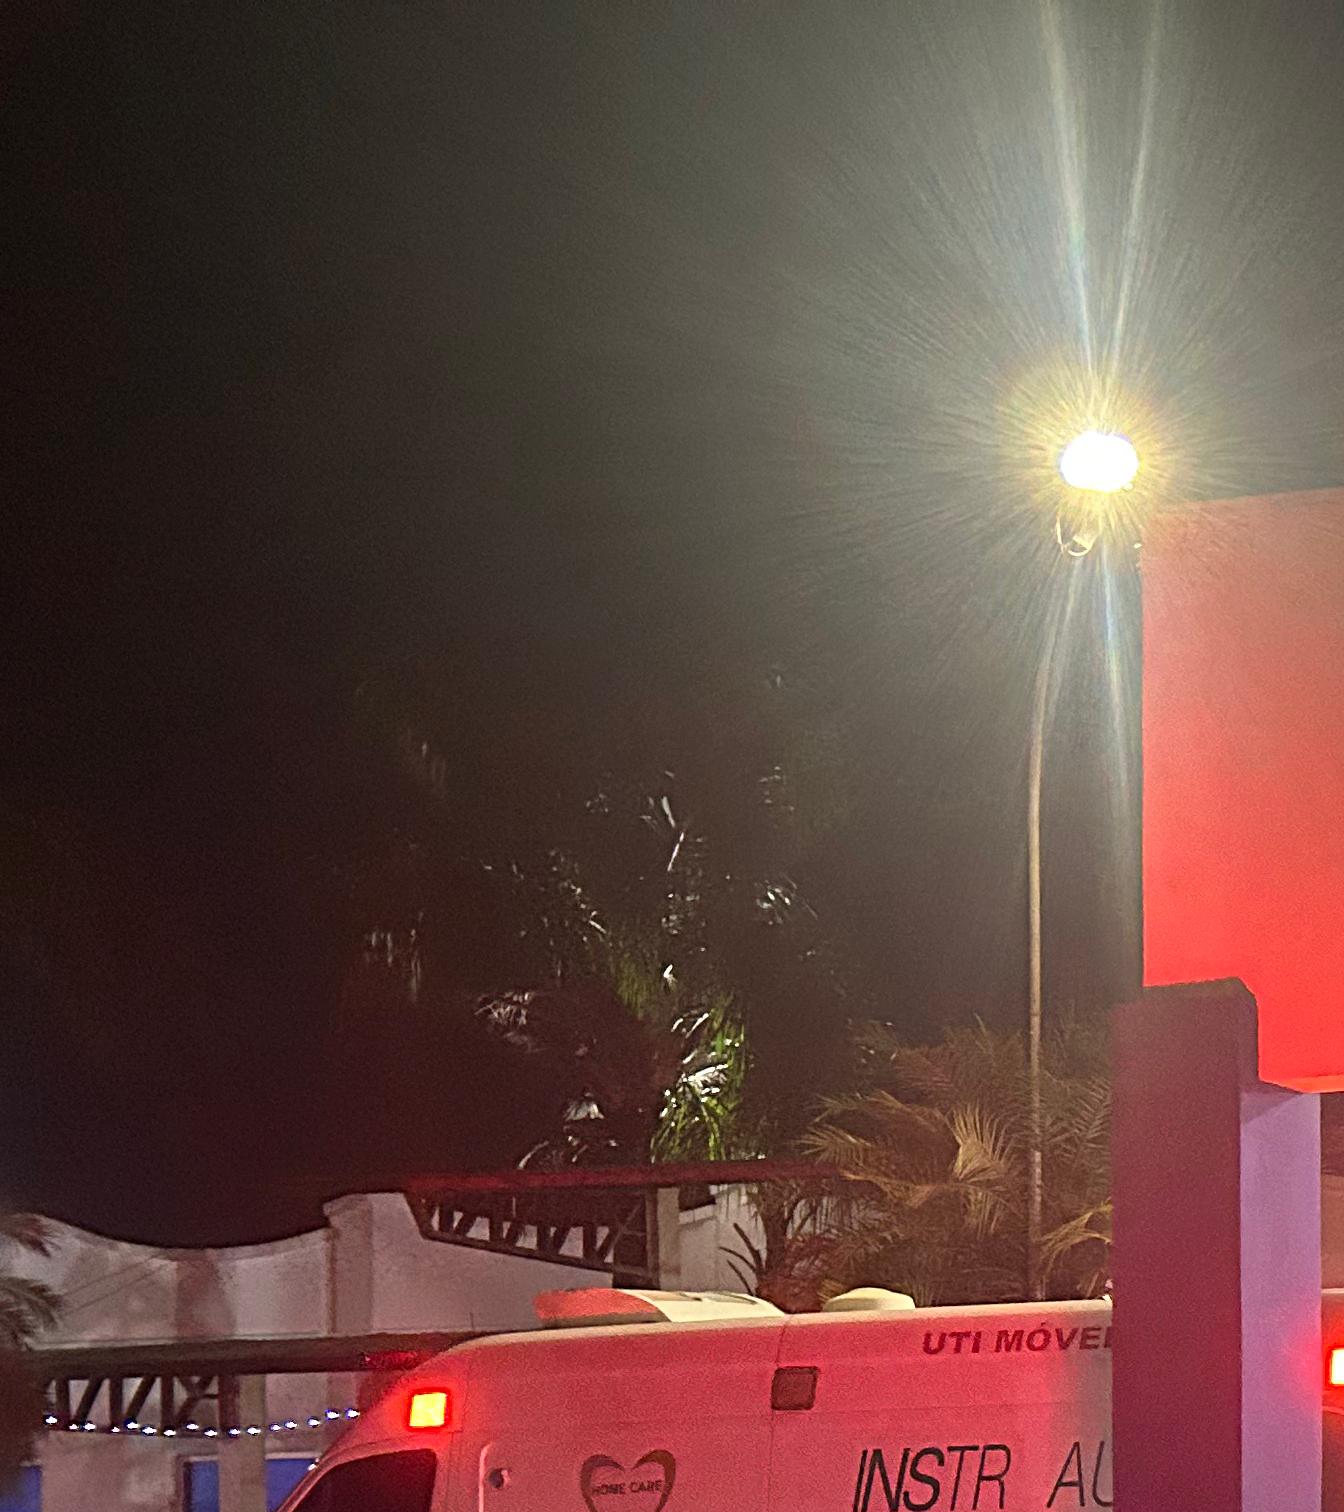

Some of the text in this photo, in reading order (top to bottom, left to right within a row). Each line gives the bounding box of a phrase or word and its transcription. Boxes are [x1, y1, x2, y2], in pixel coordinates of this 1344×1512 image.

[922, 1331, 982, 1356] UTI
[629, 1480, 663, 1494] CARE
[1046, 1440, 1113, 1509] AU
